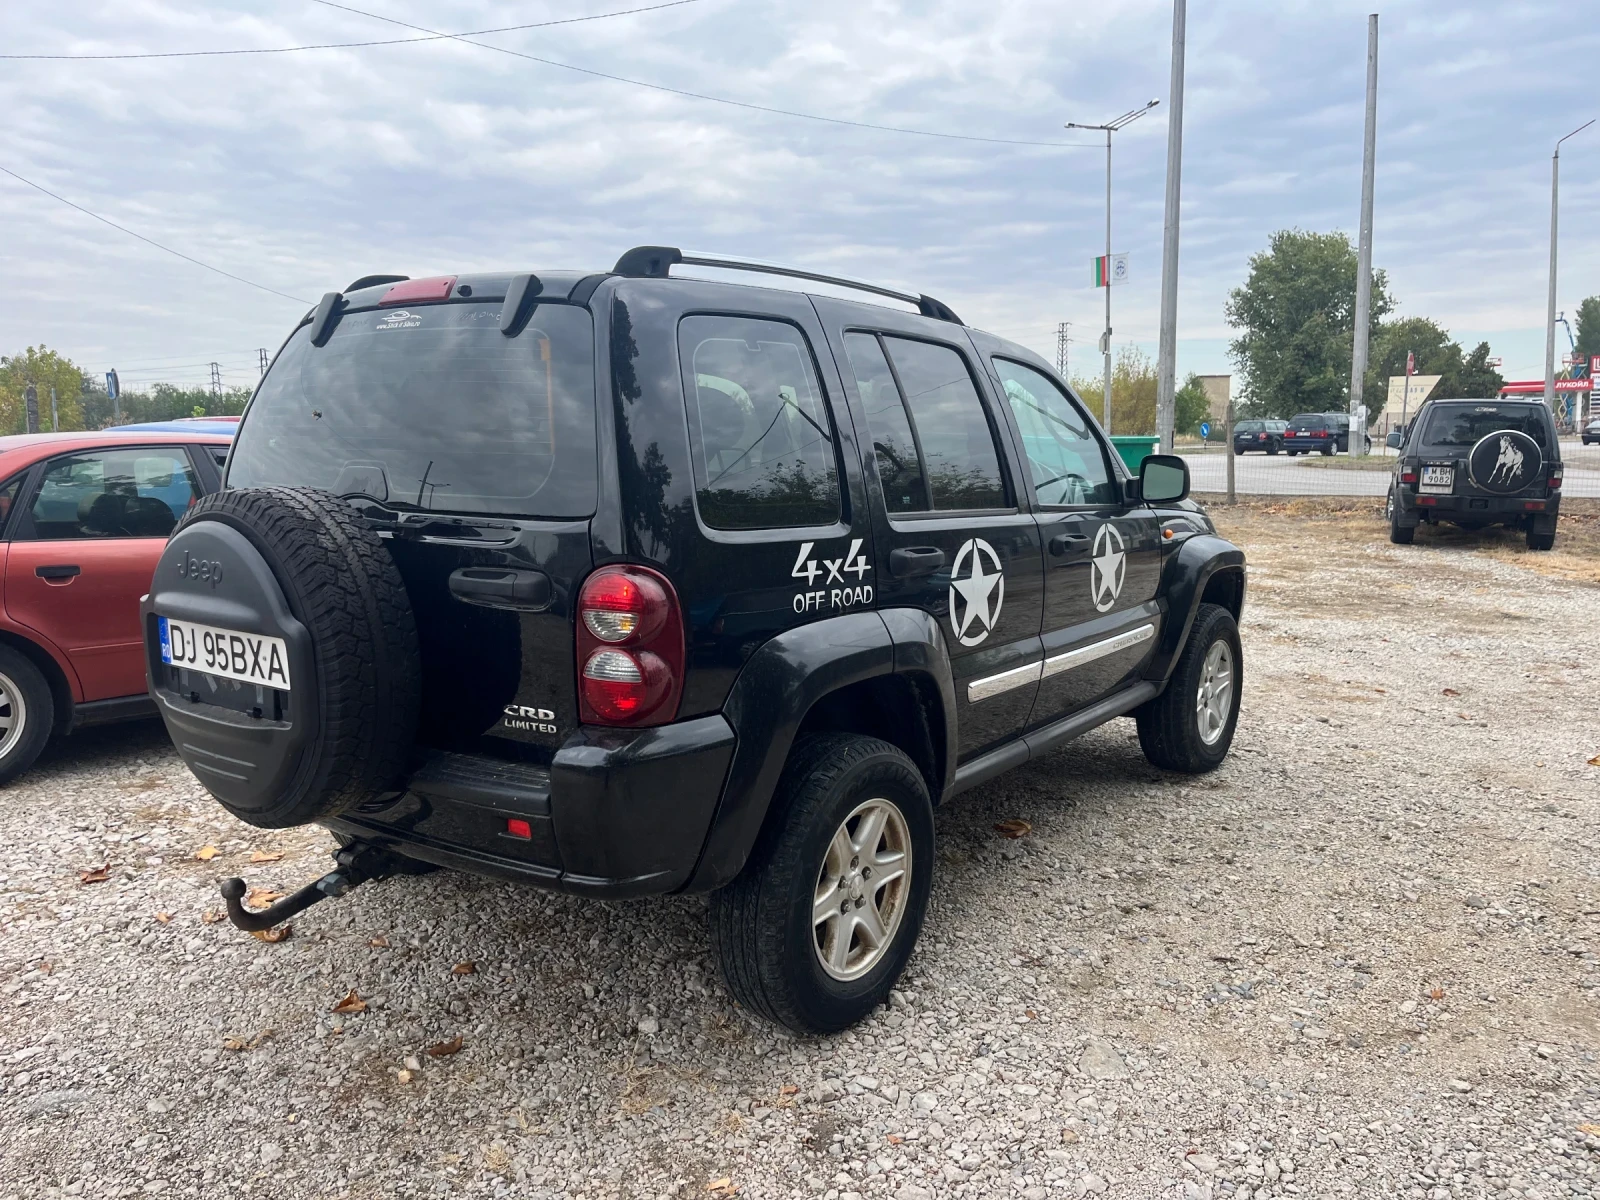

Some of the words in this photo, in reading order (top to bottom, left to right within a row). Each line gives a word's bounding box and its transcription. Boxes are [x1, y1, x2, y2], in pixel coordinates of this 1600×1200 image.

[1556, 380, 1589, 389] ЛУКОЙЛ
[1428, 475, 1450, 484] 9082
[177, 550, 223, 589] Jeep
[791, 538, 872, 587] 4x4
[793, 590, 826, 613] OFF
[831, 585, 873, 608] ROAD
[170, 624, 197, 664] DJ
[503, 704, 555, 720] CRD
[504, 718, 557, 734] LIMITED
